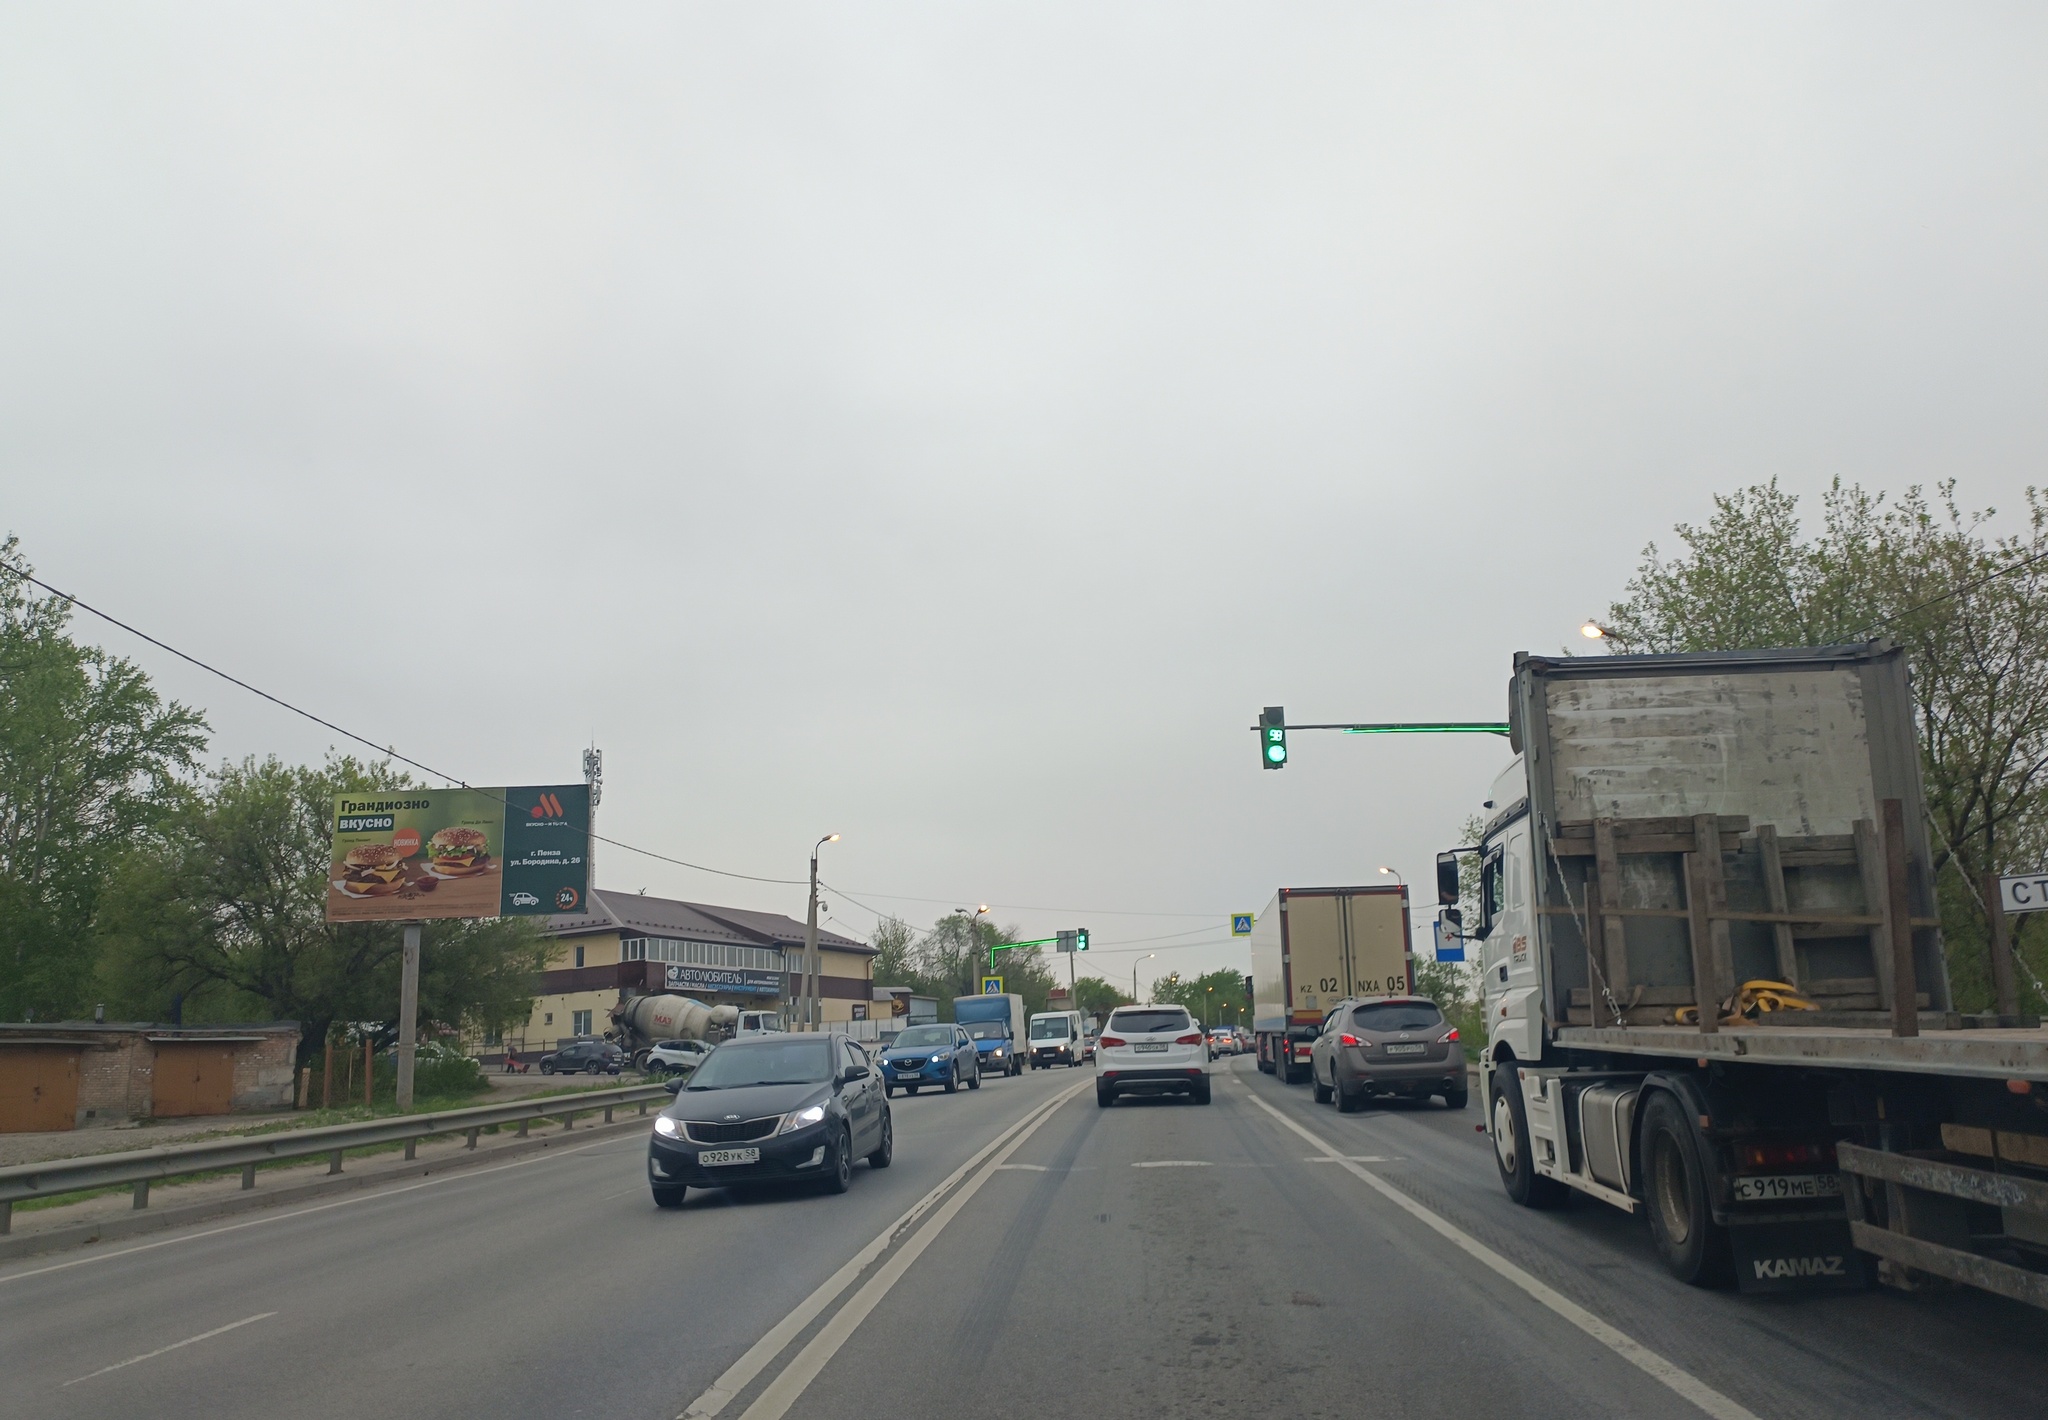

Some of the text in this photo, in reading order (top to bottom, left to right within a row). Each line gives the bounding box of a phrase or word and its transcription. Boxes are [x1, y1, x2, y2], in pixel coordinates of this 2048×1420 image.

[341, 800, 430, 814] Грандиозно
[339, 818, 392, 831] вкусно
[393, 838, 419, 847] НОВИНКА
[680, 969, 742, 984] АВТОЛЮБИТЕЛЬ
[1300, 976, 1405, 993] KZ 02 NXA 05
[654, 1014, 672, 1025] МАЗ
[702, 1149, 756, 1163] О928УК 58
[1740, 1175, 1835, 1197] С919МЕ 58
[1753, 1256, 1846, 1279] KAMAZ
